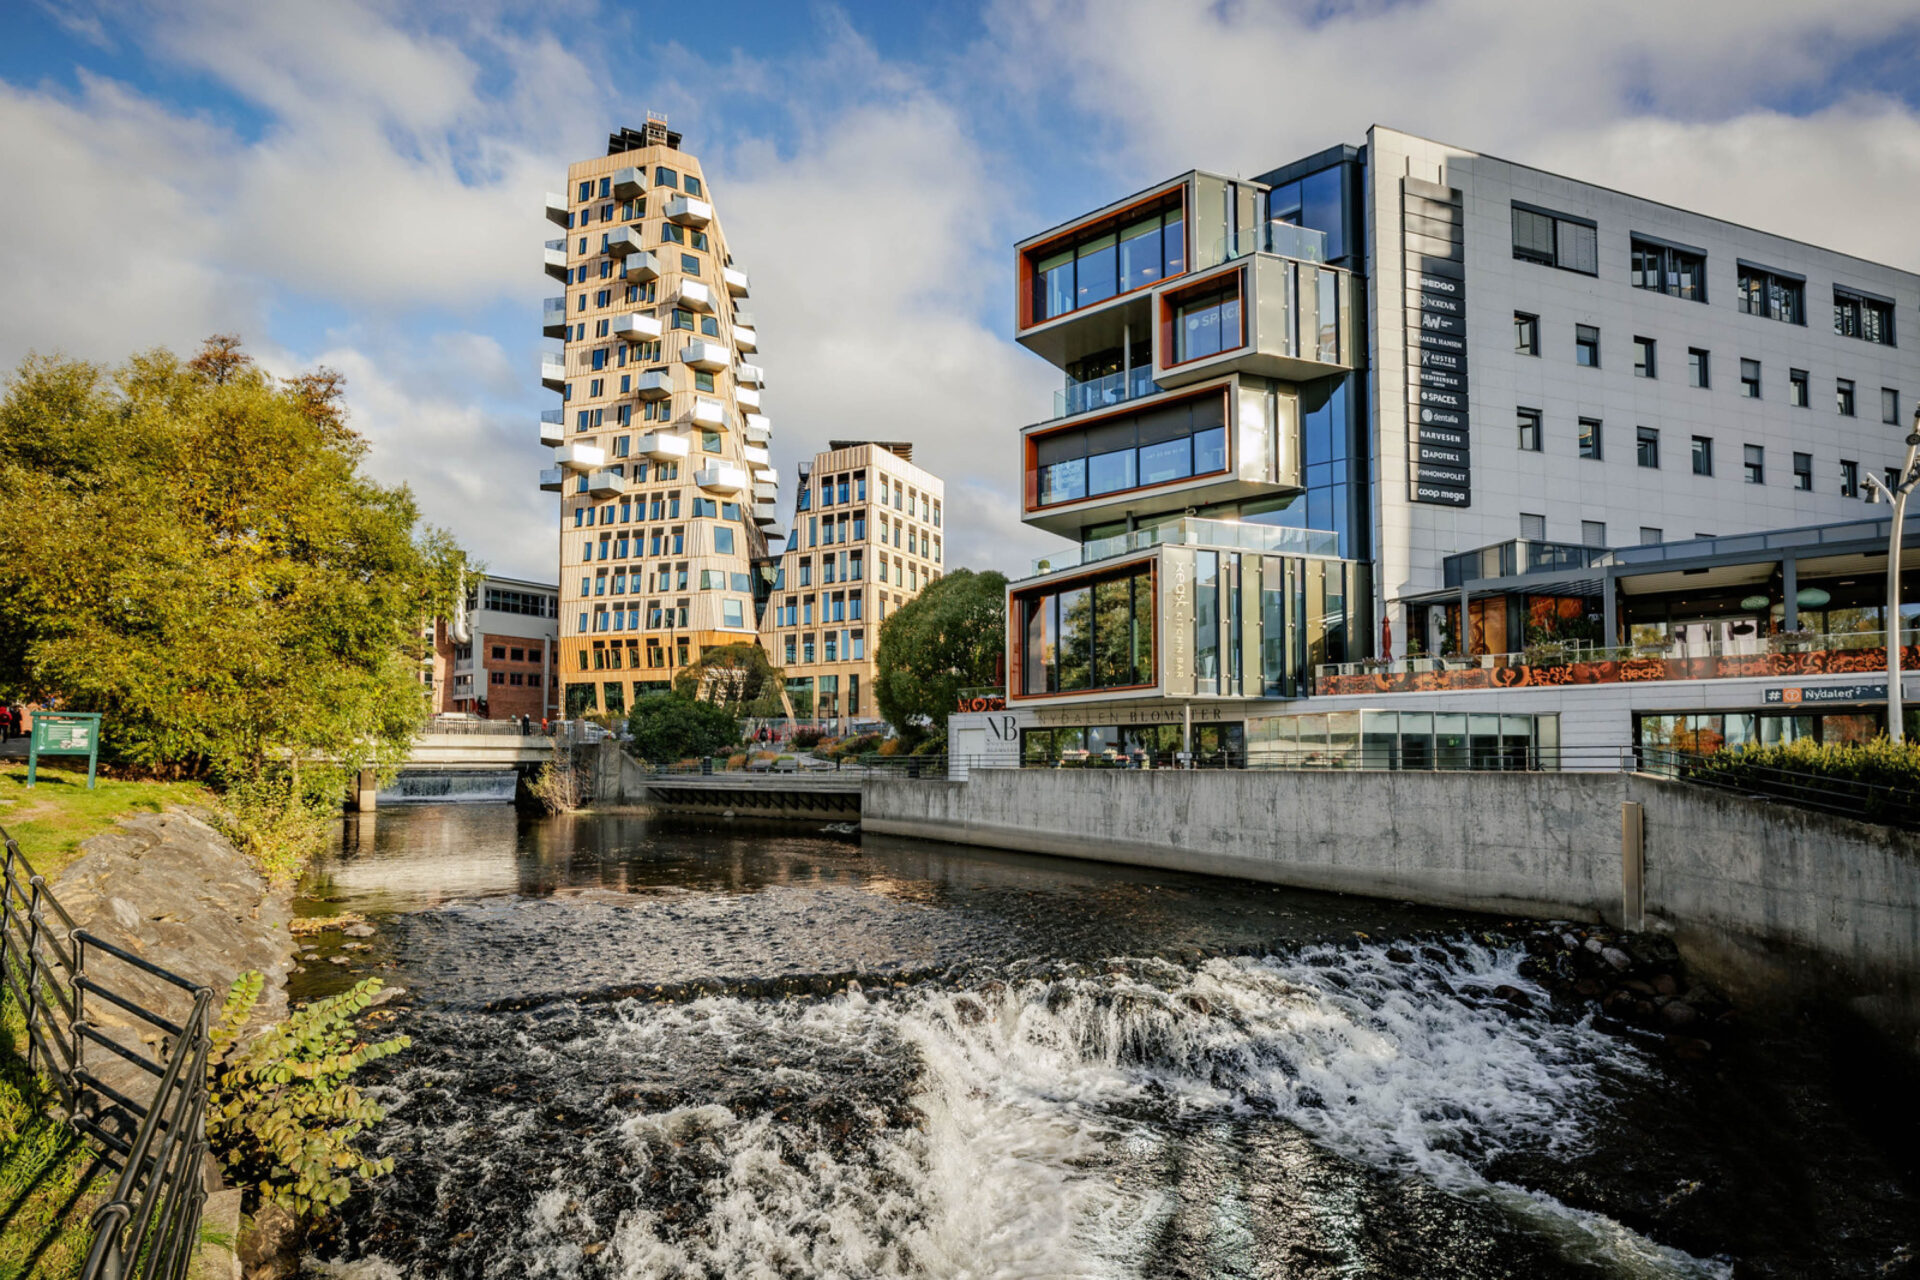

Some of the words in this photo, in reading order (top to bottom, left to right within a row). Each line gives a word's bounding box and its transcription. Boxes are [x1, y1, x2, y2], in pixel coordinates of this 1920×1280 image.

[1420, 430, 1461, 443] NARVESEN
[1417, 469, 1465, 481] VINMONOPOLET
[1418, 488, 1440, 498] coop
[1440, 491, 1465, 502] mega
[1176, 657, 1184, 678] BAR
[1037, 711, 1119, 725] NYDALEN
[1130, 708, 1221, 723] BLOMSTER
